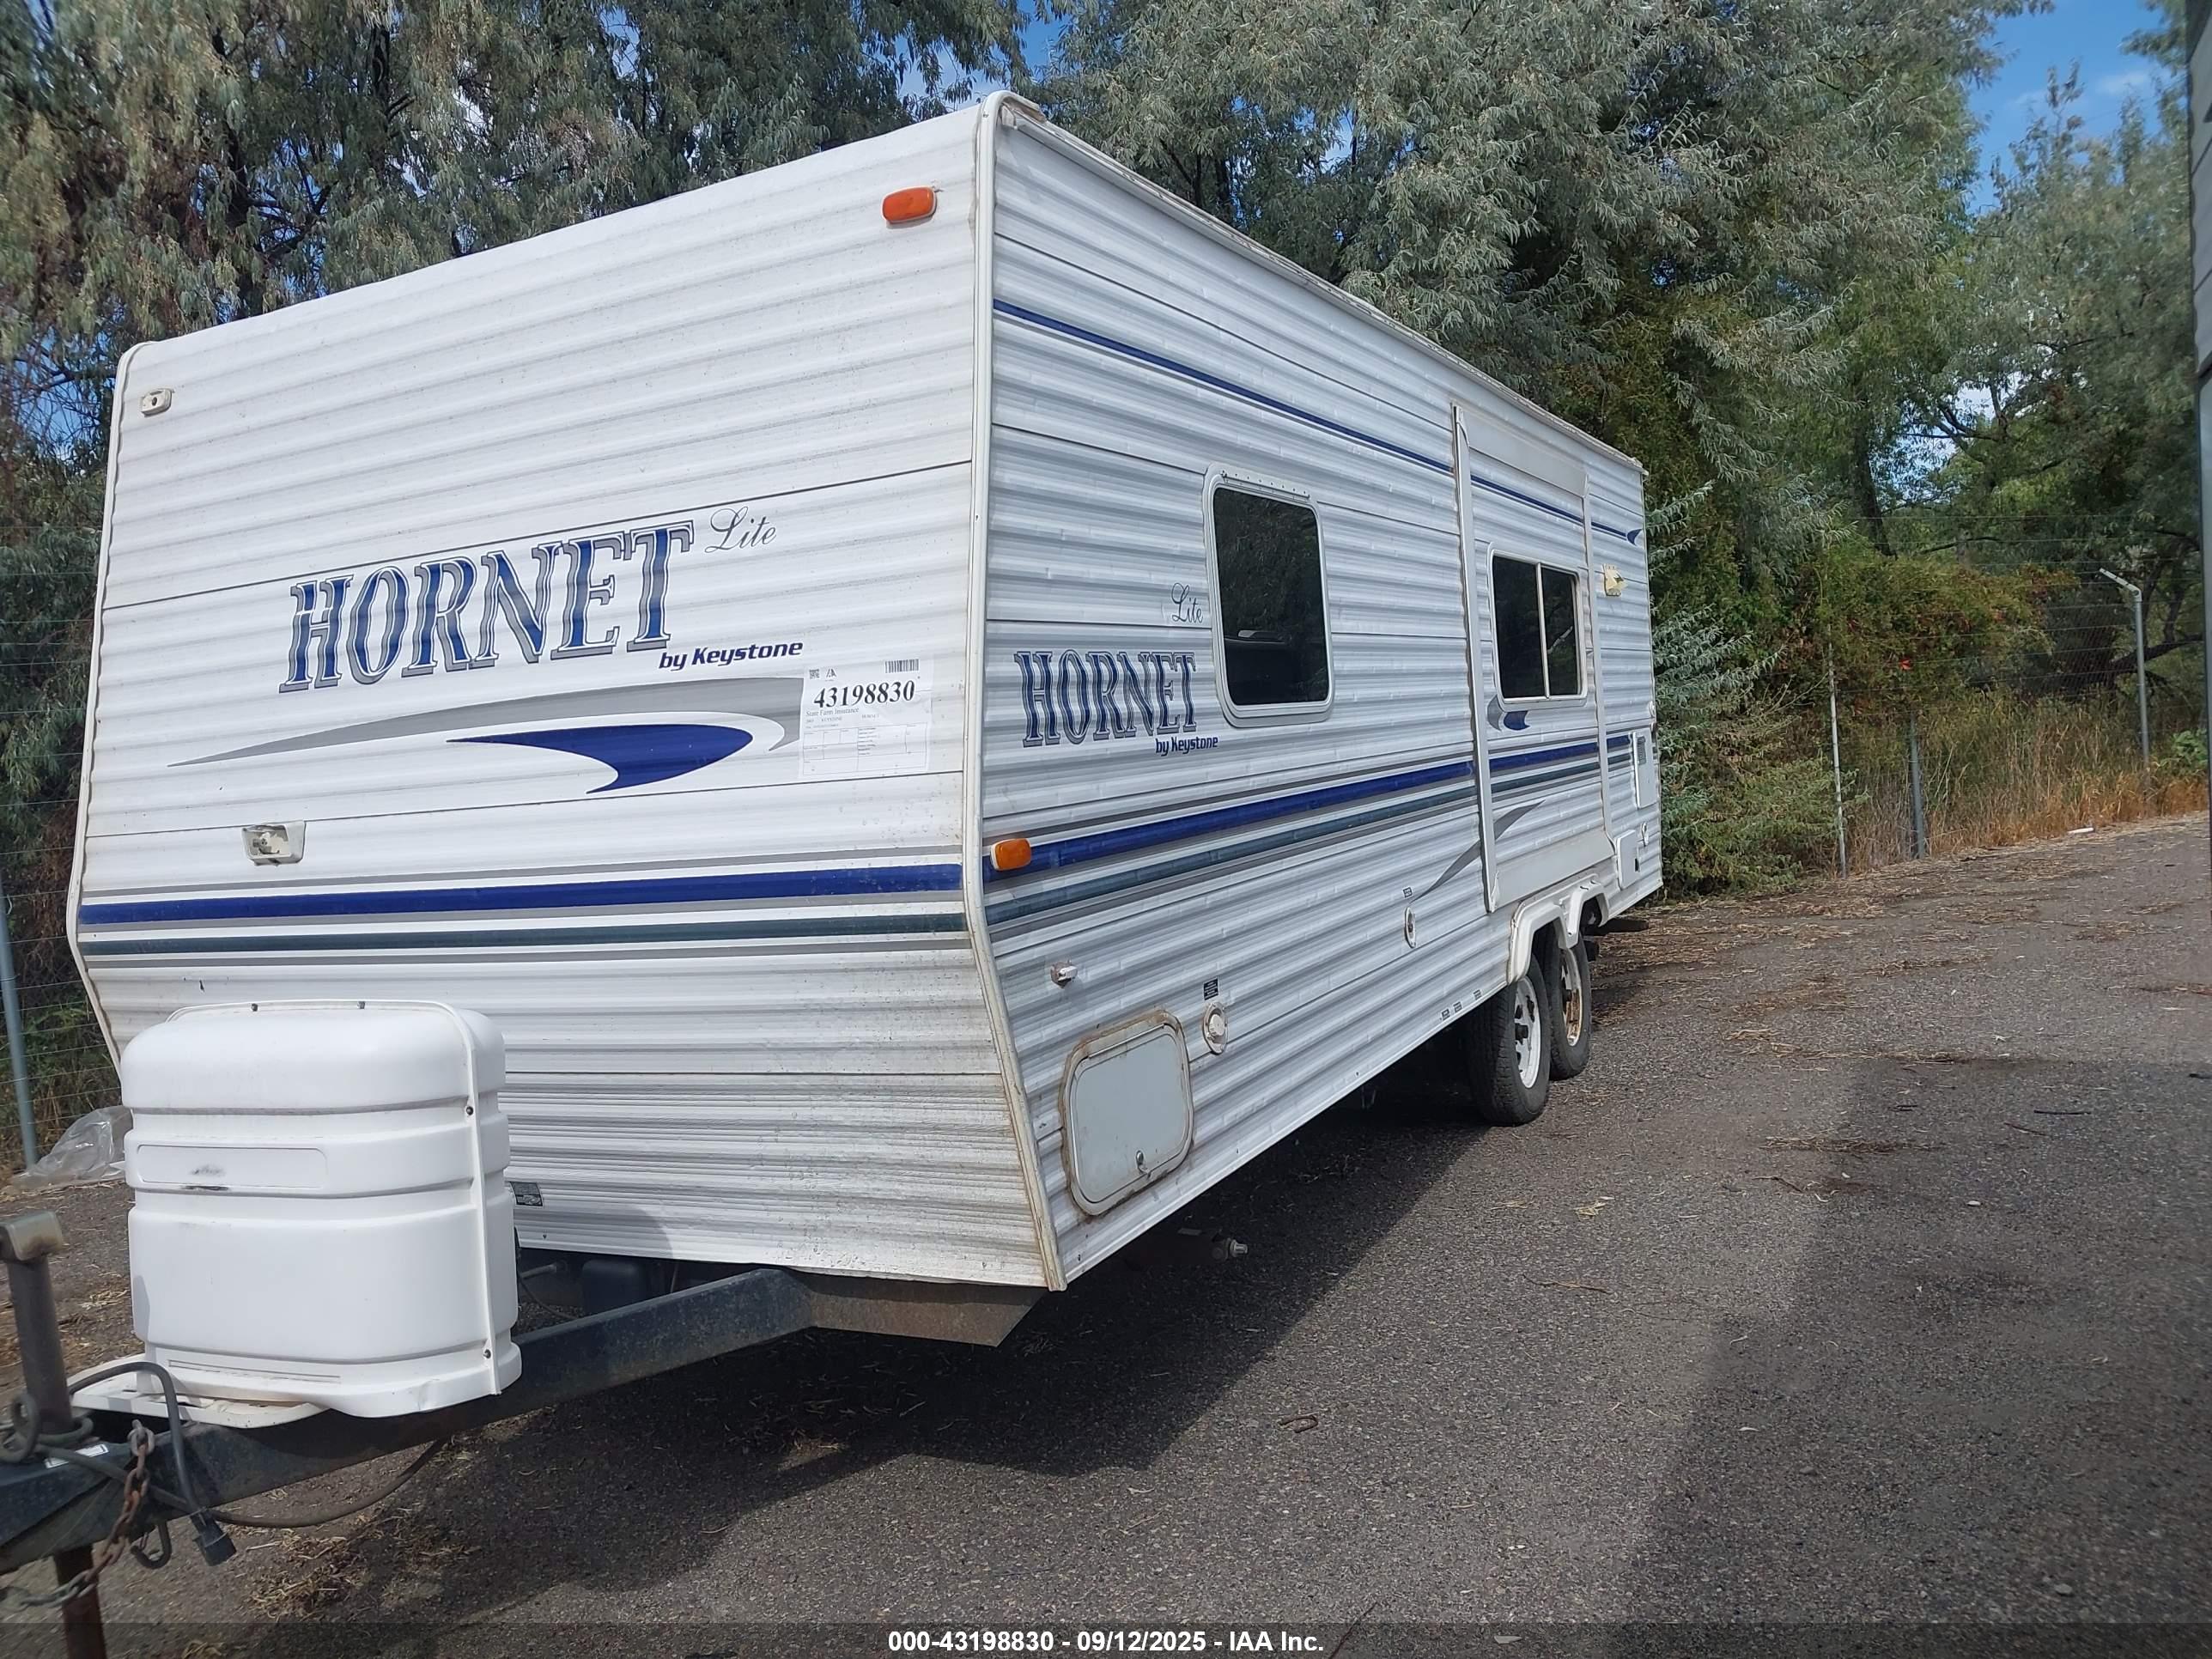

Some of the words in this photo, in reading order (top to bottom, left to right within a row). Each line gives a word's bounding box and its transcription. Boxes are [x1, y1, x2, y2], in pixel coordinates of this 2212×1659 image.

[705, 507, 776, 553] Lite
[279, 520, 694, 693] HORNET
[1170, 582, 1203, 623] Lite
[659, 652, 688, 672] by
[692, 642, 804, 667] Keystone
[814, 680, 915, 708] 43198830
[1014, 649, 1196, 748] HORNET
[1155, 738, 1170, 757] by
[1171, 736, 1218, 754] Keystone
